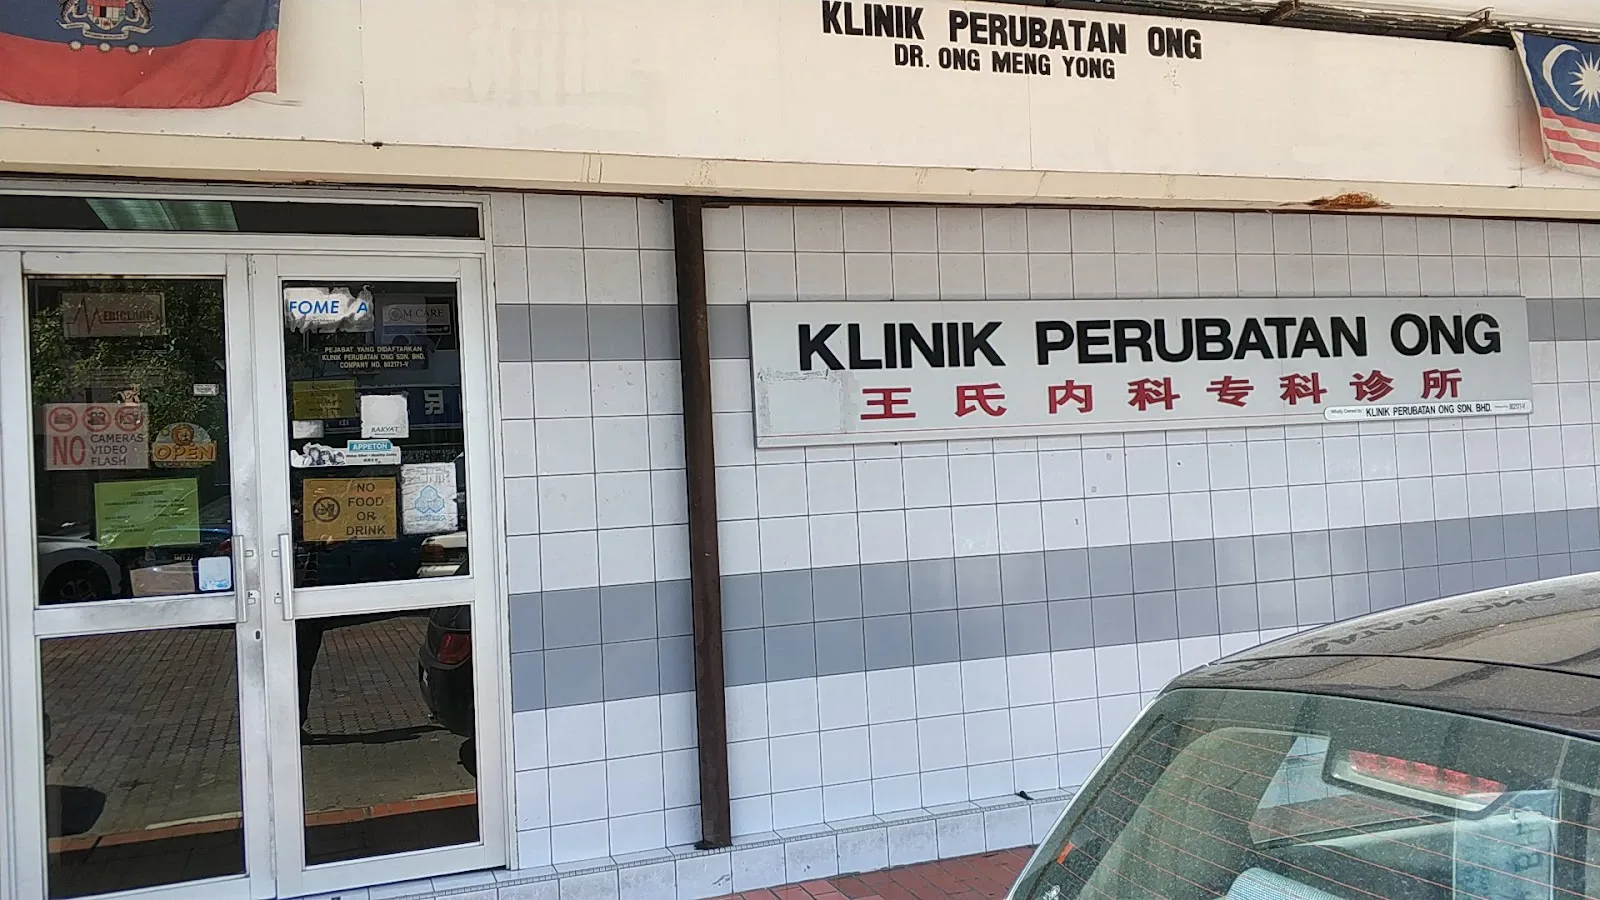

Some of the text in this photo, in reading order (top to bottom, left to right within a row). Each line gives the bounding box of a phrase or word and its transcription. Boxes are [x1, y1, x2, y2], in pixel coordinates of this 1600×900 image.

[822, 0, 1202, 60] KLINIK PERUBATAN ONG
[894, 43, 1115, 79] DR. ONG MENG YONG
[798, 313, 1501, 371] KLINIK PERUBATAN ONG
[860, 367, 1463, 420] 王氏内科专科诊所
[1365, 408, 1390, 417] KLINIK
[1393, 406, 1436, 415] PERUBATAN
[1438, 404, 1455, 414] ONG
[1457, 404, 1472, 413] SDN.
[1476, 403, 1492, 412] BHD.
[90, 434, 144, 444] CAMERAS
[53, 436, 85, 466] NO
[91, 445, 127, 455] VIDEO
[353, 442, 388, 450] APPETON
[155, 445, 214, 461] OPEN
[91, 456, 127, 466] FLASH
[357, 483, 375, 492] NO
[348, 496, 384, 507] FOOD
[357, 511, 377, 521] OR
[346, 525, 386, 536] DRINK
